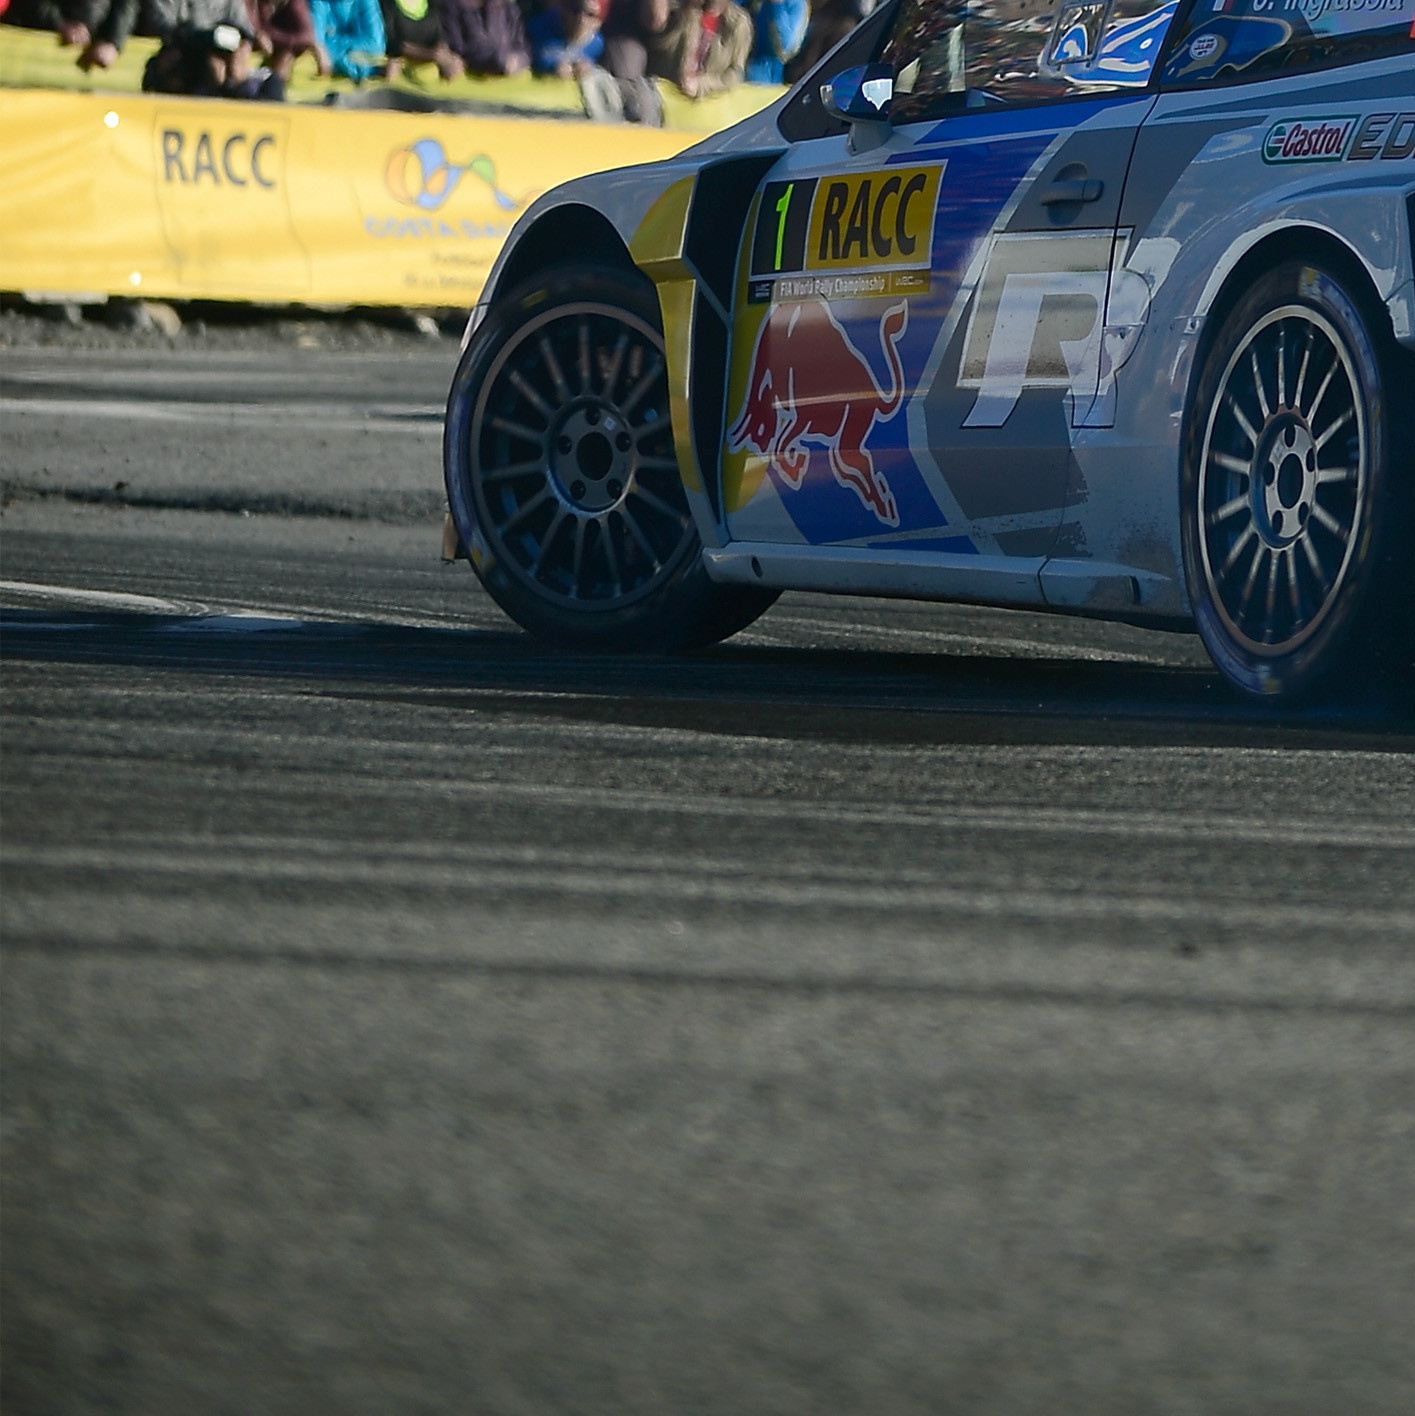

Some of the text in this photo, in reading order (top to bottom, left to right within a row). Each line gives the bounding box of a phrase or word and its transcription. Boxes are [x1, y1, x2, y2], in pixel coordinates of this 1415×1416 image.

[160, 128, 278, 188] RACC
[1281, 121, 1350, 158] Castrol
[773, 172, 927, 271] 1 RACC
[780, 281, 793, 297] FIA
[794, 280, 814, 296] World
[815, 279, 833, 297] Rally
[835, 275, 886, 294] Championship
